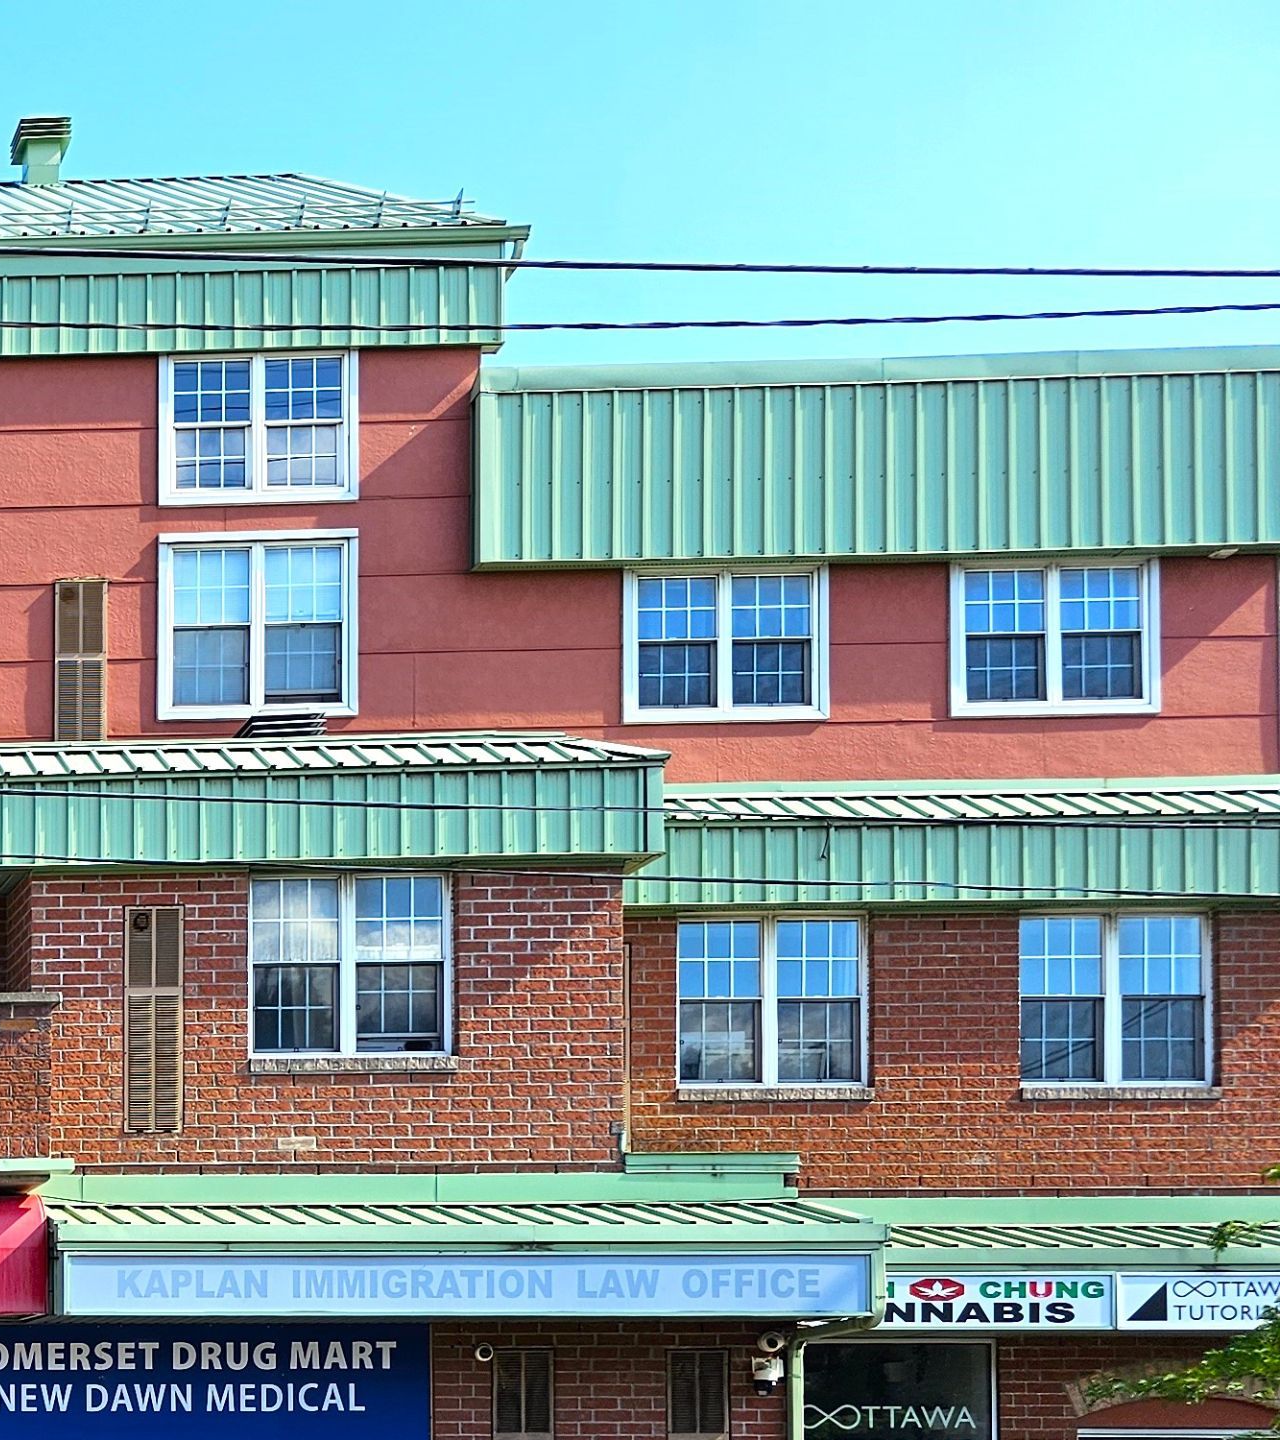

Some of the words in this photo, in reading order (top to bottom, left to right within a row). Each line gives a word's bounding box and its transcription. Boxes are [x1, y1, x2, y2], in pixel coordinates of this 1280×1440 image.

[116, 1269, 269, 1298] KAPLAN
[292, 1268, 553, 1299] IMMIGRATION
[576, 1268, 660, 1299] LAW
[681, 1268, 821, 1299] OFFICE
[978, 1280, 1105, 1299] CHUNG
[1172, 1280, 1280, 1298] OTTAW
[884, 1302, 1076, 1323] NNABIS
[1172, 1304, 1262, 1321] TUTORI
[172, 1341, 278, 1371] DRUG
[289, 1340, 397, 1370] MART
[85, 1382, 193, 1412] DAWN
[205, 1382, 366, 1412] MEDICAL
